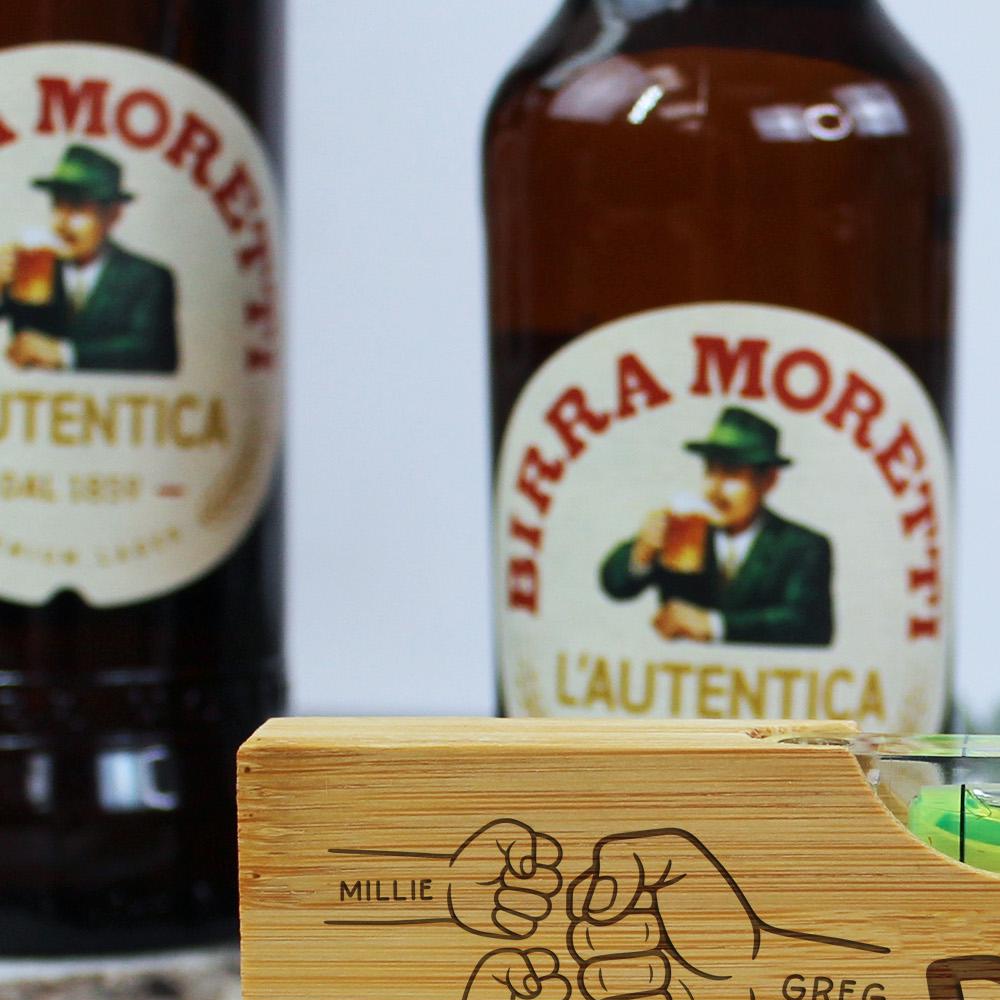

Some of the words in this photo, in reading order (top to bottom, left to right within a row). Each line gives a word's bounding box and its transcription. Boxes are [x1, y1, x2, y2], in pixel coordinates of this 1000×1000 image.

[507, 353, 673, 616] BIRRA
[688, 334, 940, 641] MORETTI
[555, 652, 887, 721] L'AUTENTICA
[339, 879, 434, 902] MILLIE
